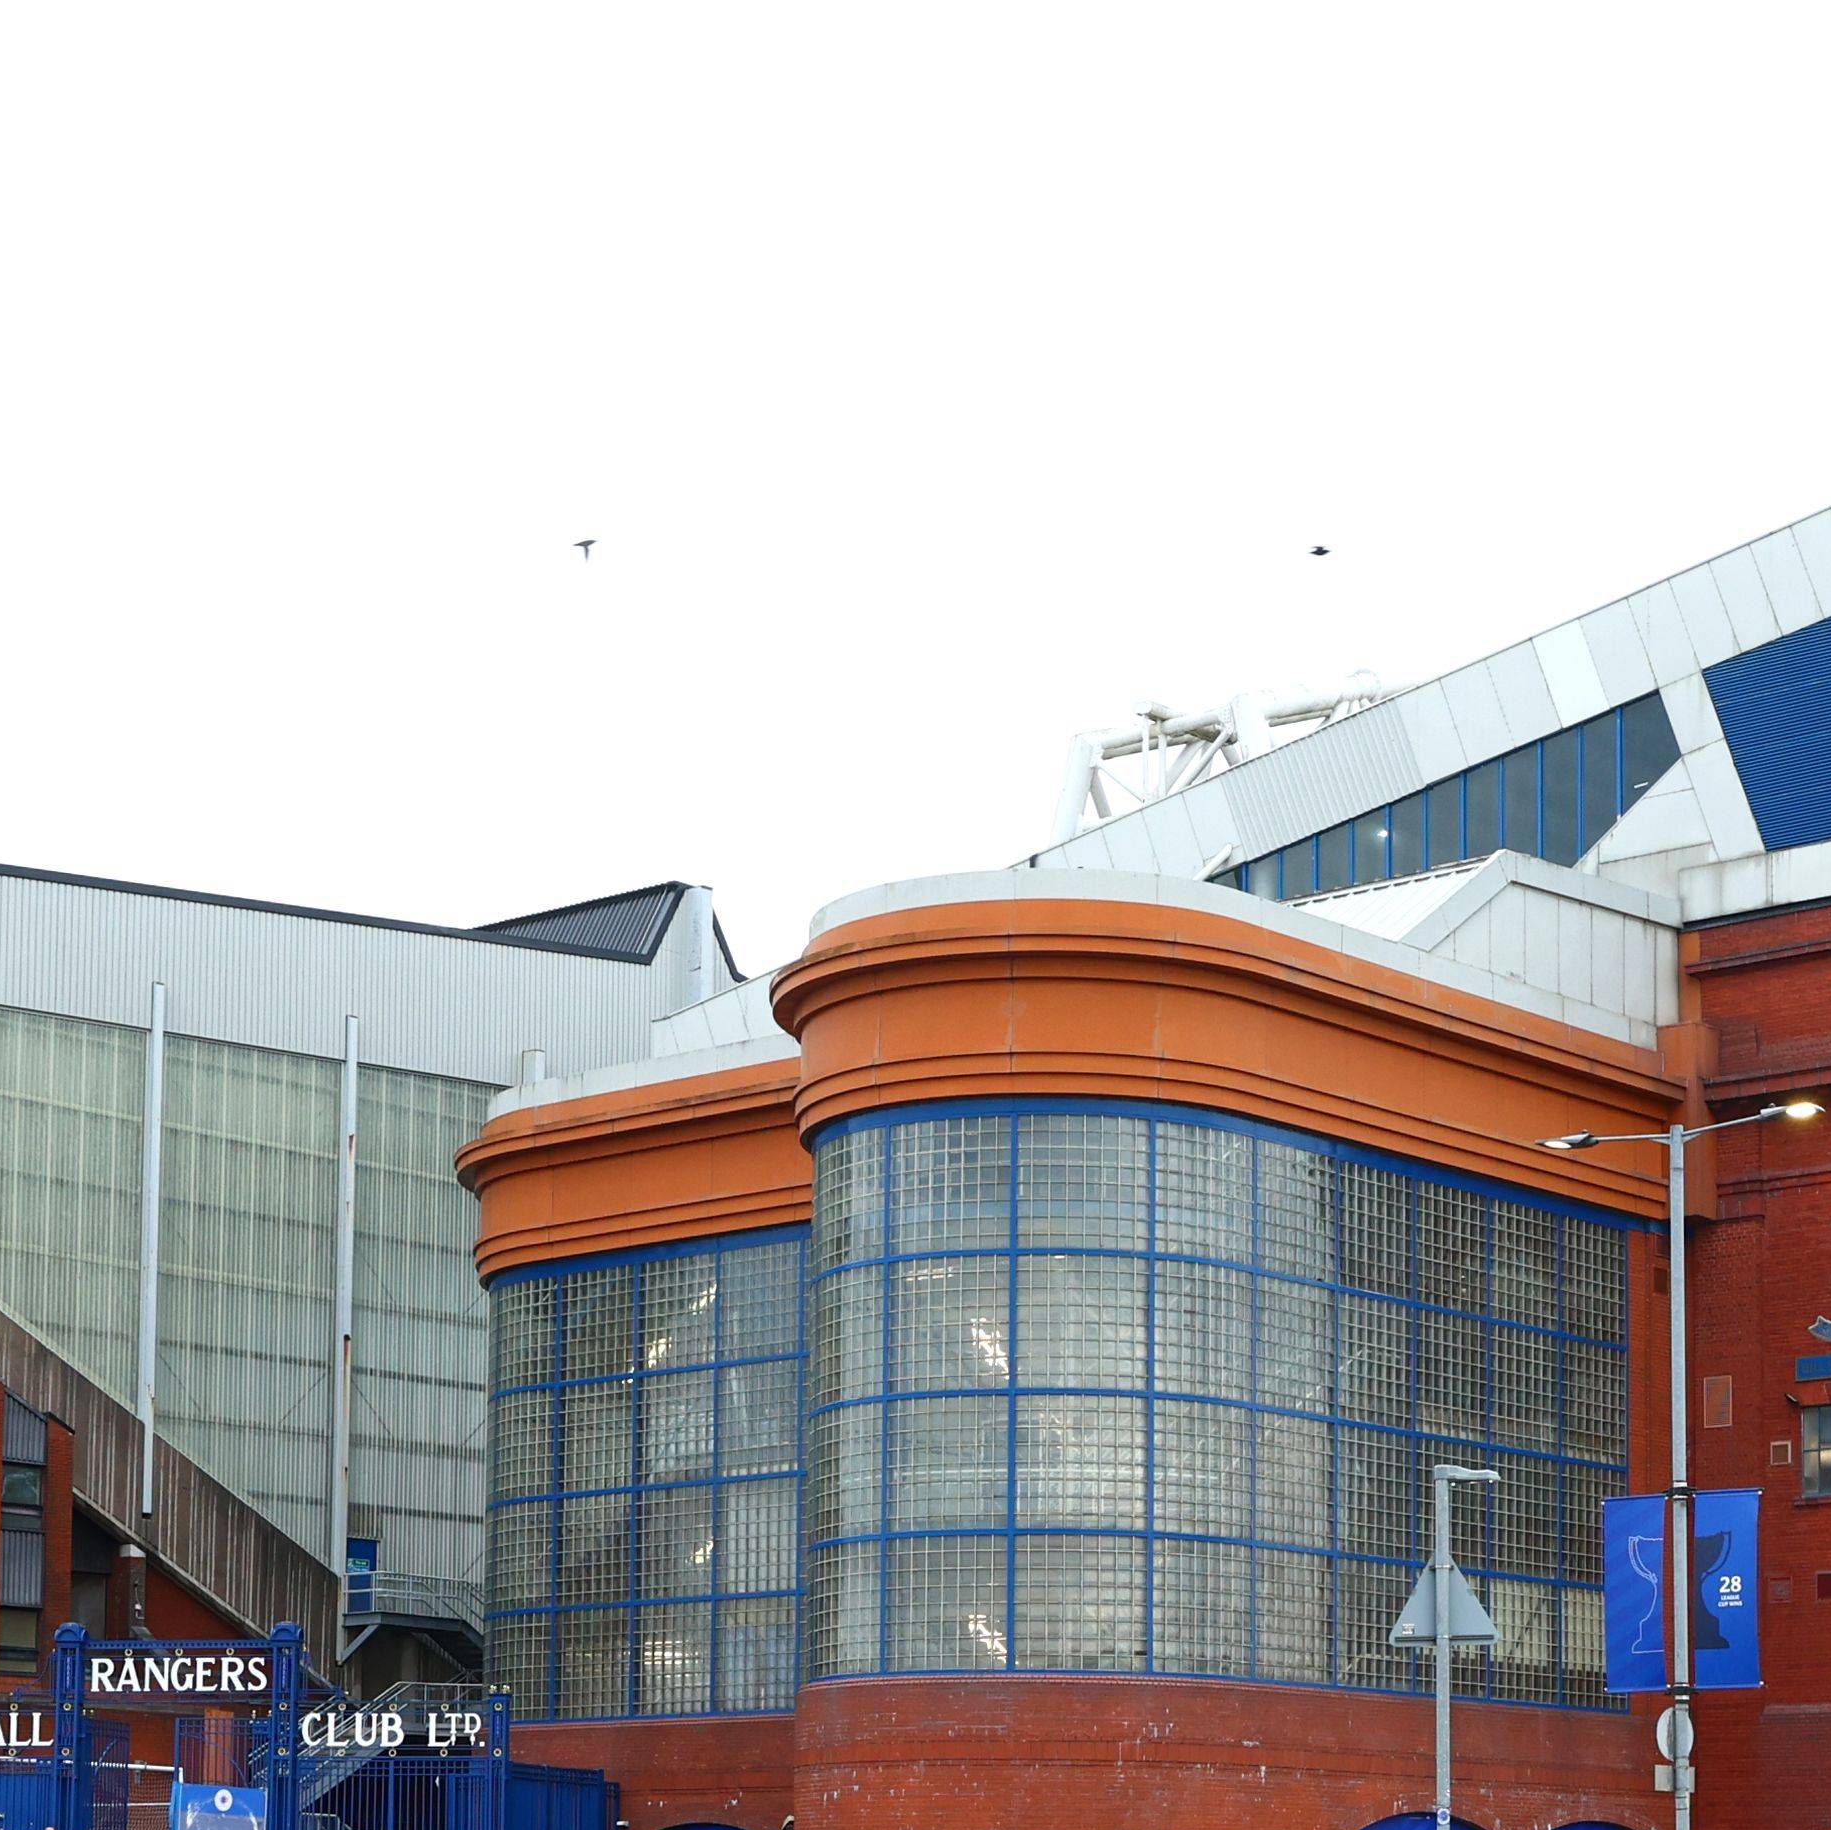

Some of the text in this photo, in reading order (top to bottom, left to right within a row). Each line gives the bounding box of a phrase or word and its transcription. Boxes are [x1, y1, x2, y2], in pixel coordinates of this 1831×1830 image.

[1719, 1575, 1742, 1593] 28
[90, 1657, 268, 1694] RANGERS
[301, 1712, 405, 1748] CLUB
